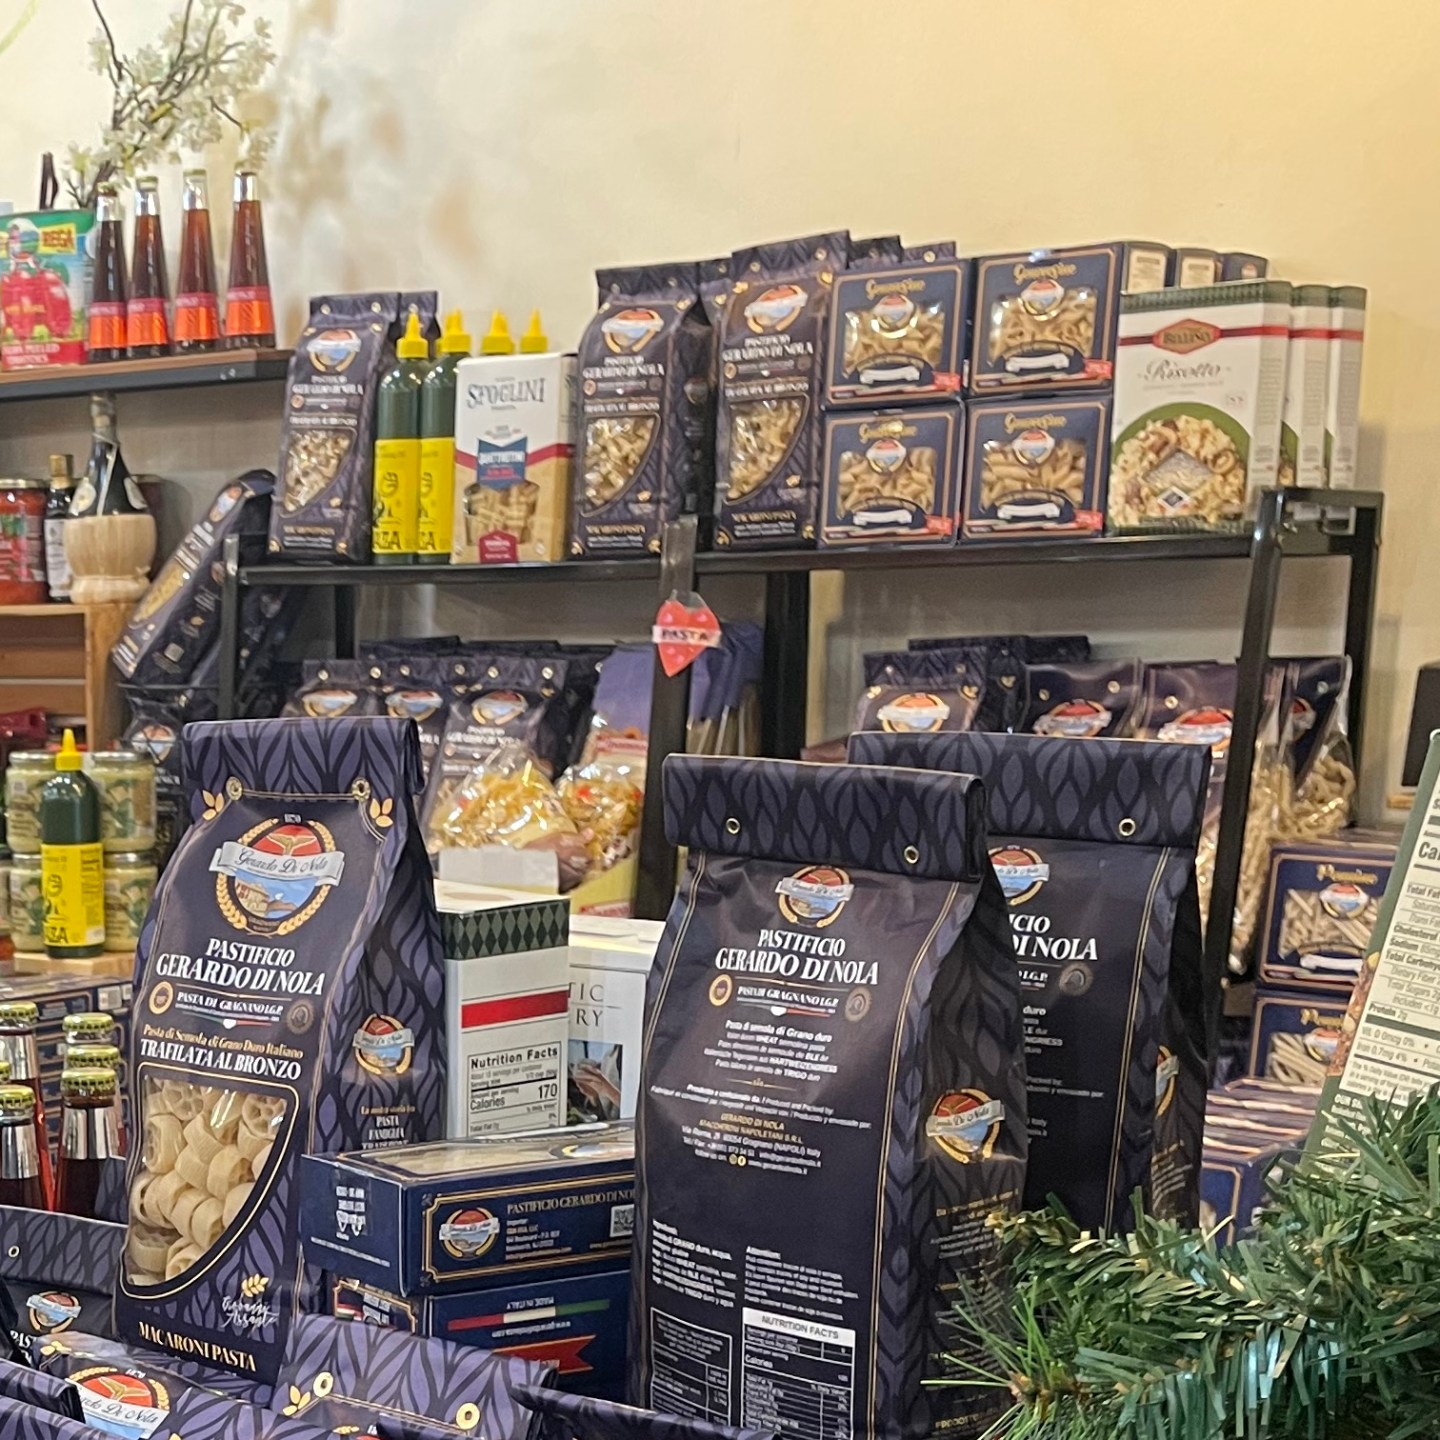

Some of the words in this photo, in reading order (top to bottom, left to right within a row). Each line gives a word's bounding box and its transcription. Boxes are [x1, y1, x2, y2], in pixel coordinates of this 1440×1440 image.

[1144, 360, 1221, 382] Risotto
[662, 629, 707, 640] PASTA
[205, 937, 295, 968] PASTIFICIO
[758, 929, 846, 957] PASTIFICIO
[1032, 937, 1097, 961] NOLA
[156, 952, 250, 990] GERARDO
[250, 971, 275, 991] DI
[278, 971, 327, 995] NOLA
[715, 947, 799, 975] GERARDO
[799, 957, 828, 981] DI
[829, 960, 879, 986] NOLA
[140, 1038, 213, 1068] TRAFILATA
[213, 1050, 233, 1071] AL
[233, 1052, 301, 1080] BRONZO
[471, 1052, 522, 1070] Nutrition
[527, 1046, 558, 1062] Facts
[470, 1096, 505, 1111] Calories
[538, 1083, 558, 1099] 170
[507, 1200, 559, 1215] PASTIFICIO
[560, 1193, 605, 1207] GERARDO
[138, 1321, 211, 1362] MACARONI
[211, 1342, 256, 1372] PASTA
